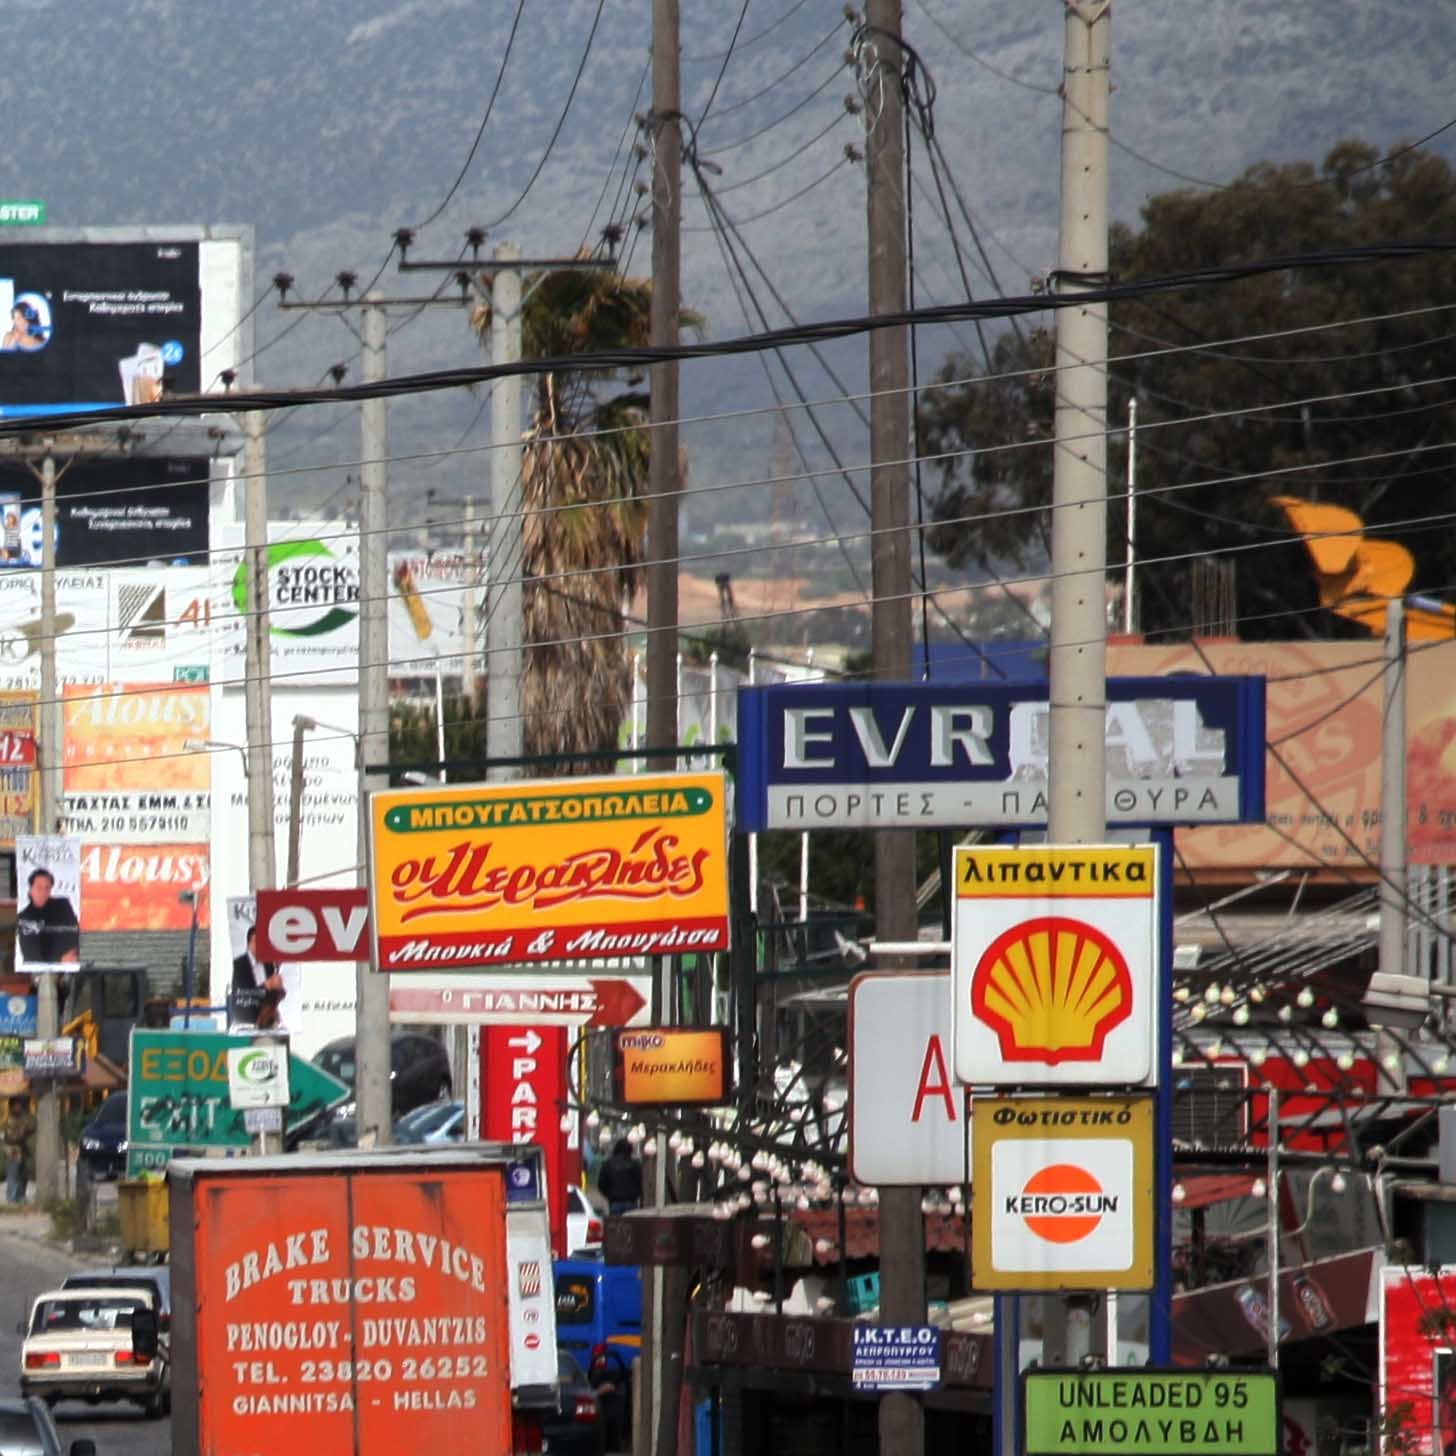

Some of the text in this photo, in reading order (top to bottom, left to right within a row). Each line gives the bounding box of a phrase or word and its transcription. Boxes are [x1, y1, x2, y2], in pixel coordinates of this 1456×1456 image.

[277, 567, 347, 586] STOCK
[276, 586, 360, 604] CENTER
[410, 791, 689, 830] ΜΠΟΥΓΑΤΣΟΠΩΛΕΙΑ
[786, 791, 936, 818] ΠΟΡΤΕΣ
[1002, 787, 1219, 815] ΠΑΘΥΡΑ
[962, 857, 1148, 884] λιπαντικα
[389, 936, 513, 964] Μπουκιά
[527, 930, 555, 955] &
[566, 925, 720, 954] Μπουγάτσα
[141, 1047, 230, 1083] ΕΞΟΔ
[629, 1060, 716, 1079] Μερακλήδες
[140, 1096, 222, 1130] EXIT
[992, 1104, 1133, 1128] Φωτιστικό
[1005, 1195, 1119, 1216] KERO-SUN
[224, 1226, 486, 1302] BRAKE SERVICE
[287, 1277, 417, 1306] TRUCKS
[363, 1317, 486, 1348] DUVANTZIS
[232, 1357, 488, 1384] TEL. 23820 26252
[232, 1391, 355, 1417] GIANNITSA
[393, 1388, 477, 1412] HELLAS
[1059, 1381, 1249, 1409] UNLEADED 95
[1060, 1419, 1244, 1444] ΑΜΟΛΥΒΔΗ
